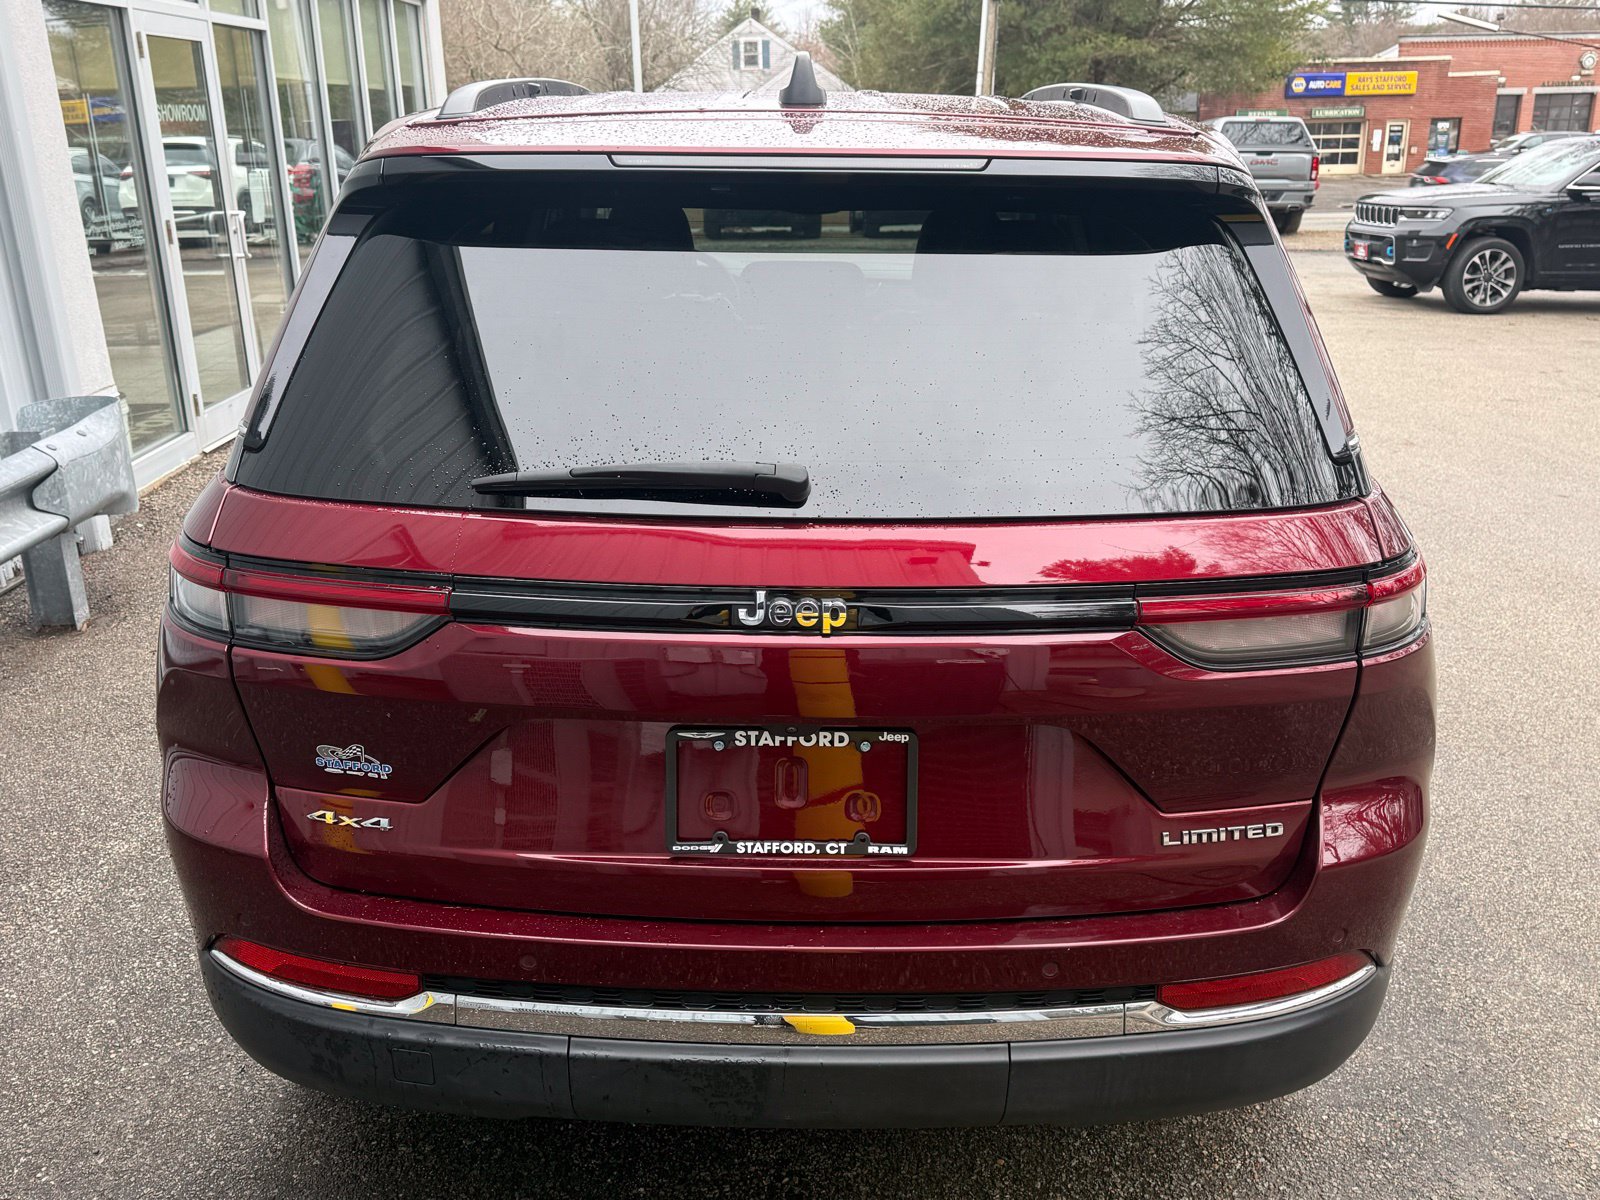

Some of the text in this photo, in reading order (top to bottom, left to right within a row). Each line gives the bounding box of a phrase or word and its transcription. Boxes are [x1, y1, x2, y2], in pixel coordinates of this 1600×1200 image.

[1308, 80, 1325, 89] AUTO
[1325, 80, 1342, 88] CARE
[1375, 75, 1407, 83] STAFFORD
[156, 104, 207, 122] SHOWROOM
[1315, 108, 1361, 117] LUBRICATION
[1249, 158, 1279, 166] GMC
[737, 590, 848, 634] Jeep
[735, 730, 850, 748] STAFFORD
[878, 731, 910, 745] Jeep
[315, 756, 393, 774] STAFFORD
[306, 809, 394, 831] 4x4
[1161, 822, 1285, 846] LIMITED
[736, 842, 848, 855] STAFFORD, CT
[867, 845, 908, 855] RAM
